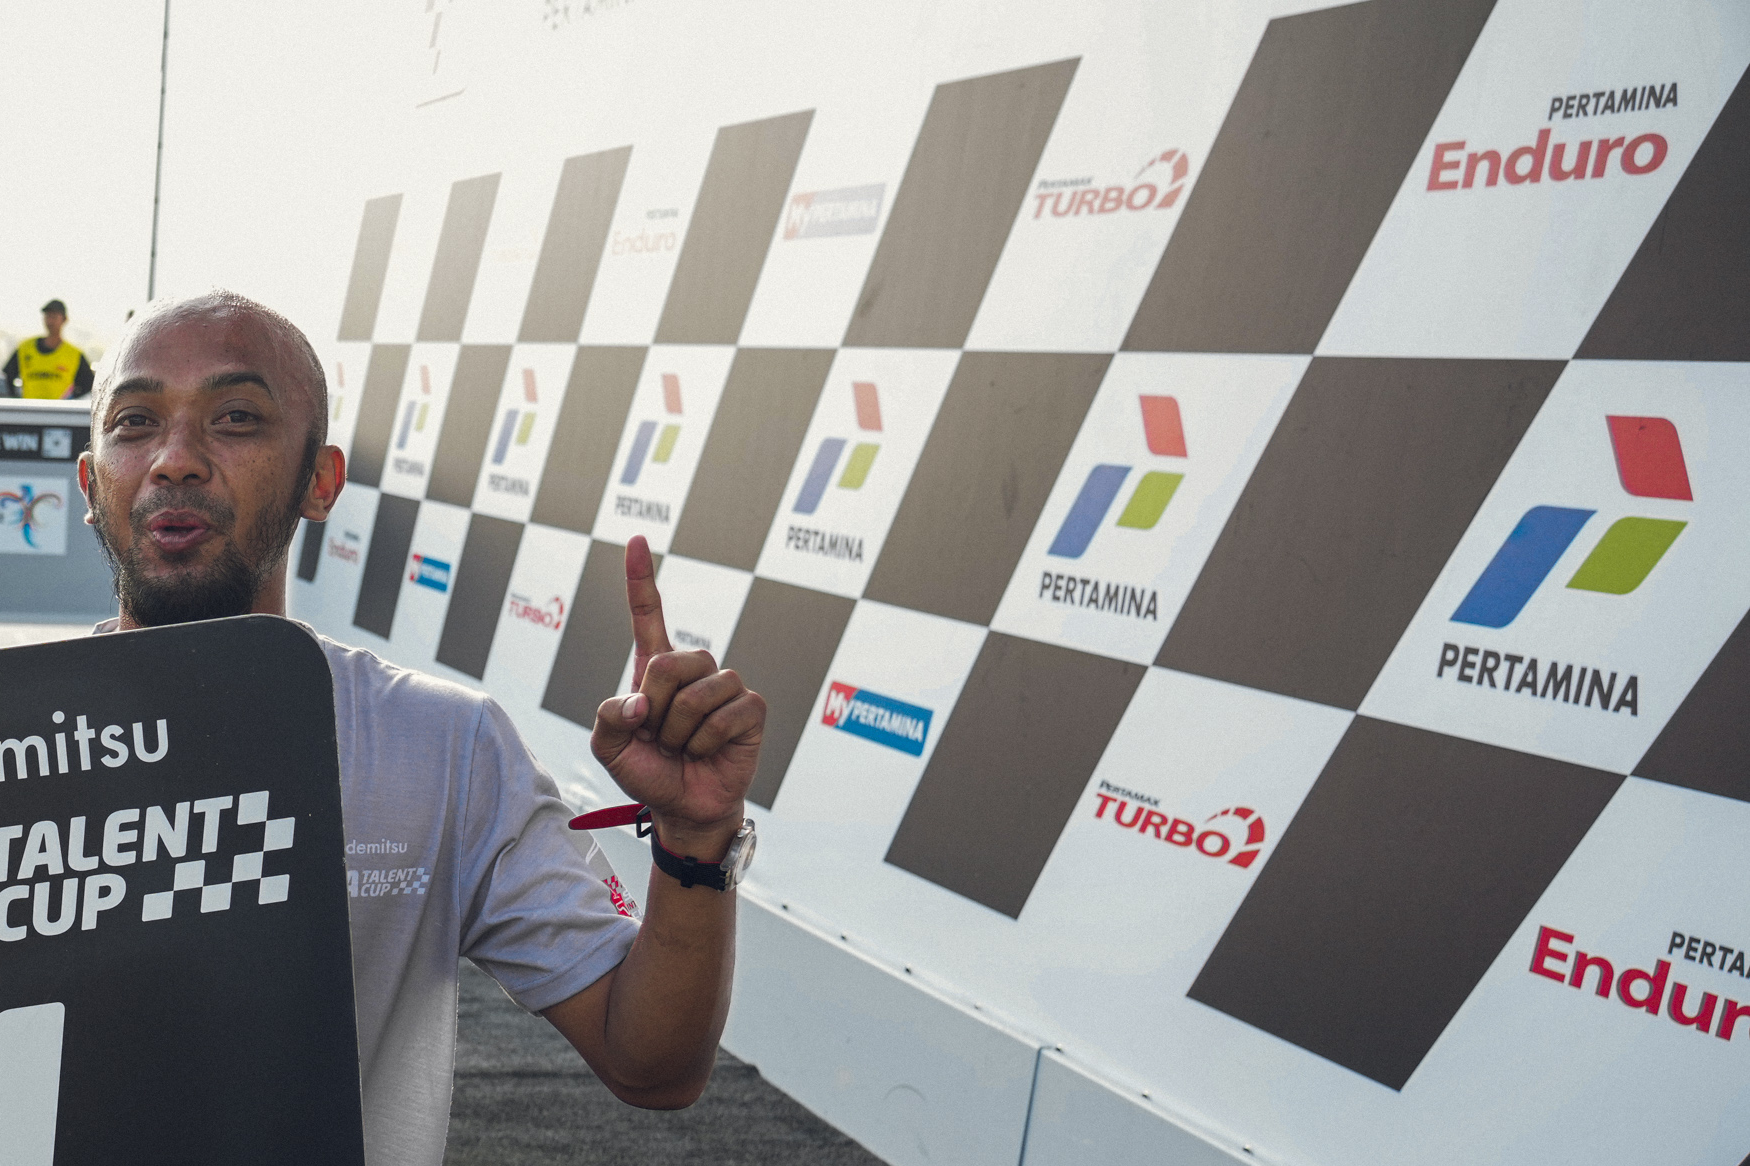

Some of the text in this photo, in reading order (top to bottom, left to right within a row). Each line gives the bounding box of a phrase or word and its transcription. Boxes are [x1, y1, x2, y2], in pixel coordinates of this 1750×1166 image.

[1548, 82, 1679, 121] PERTAMINA
[1426, 128, 1669, 191] Enduro
[1034, 184, 1158, 220] TURBO
[1, 432, 38, 452] WIN
[786, 524, 865, 564] PERTAMINA
[1039, 571, 1160, 623] PERTAMINA
[1436, 642, 1641, 718] PERTAMINA
[825, 690, 925, 743] MyPERTAMINA
[1095, 793, 1231, 858] TURBO
[360, 883, 391, 897] CUP
[361, 868, 417, 884] TALENT
[1667, 930, 1750, 980] PERTA
[1529, 924, 1750, 1042] Endur
